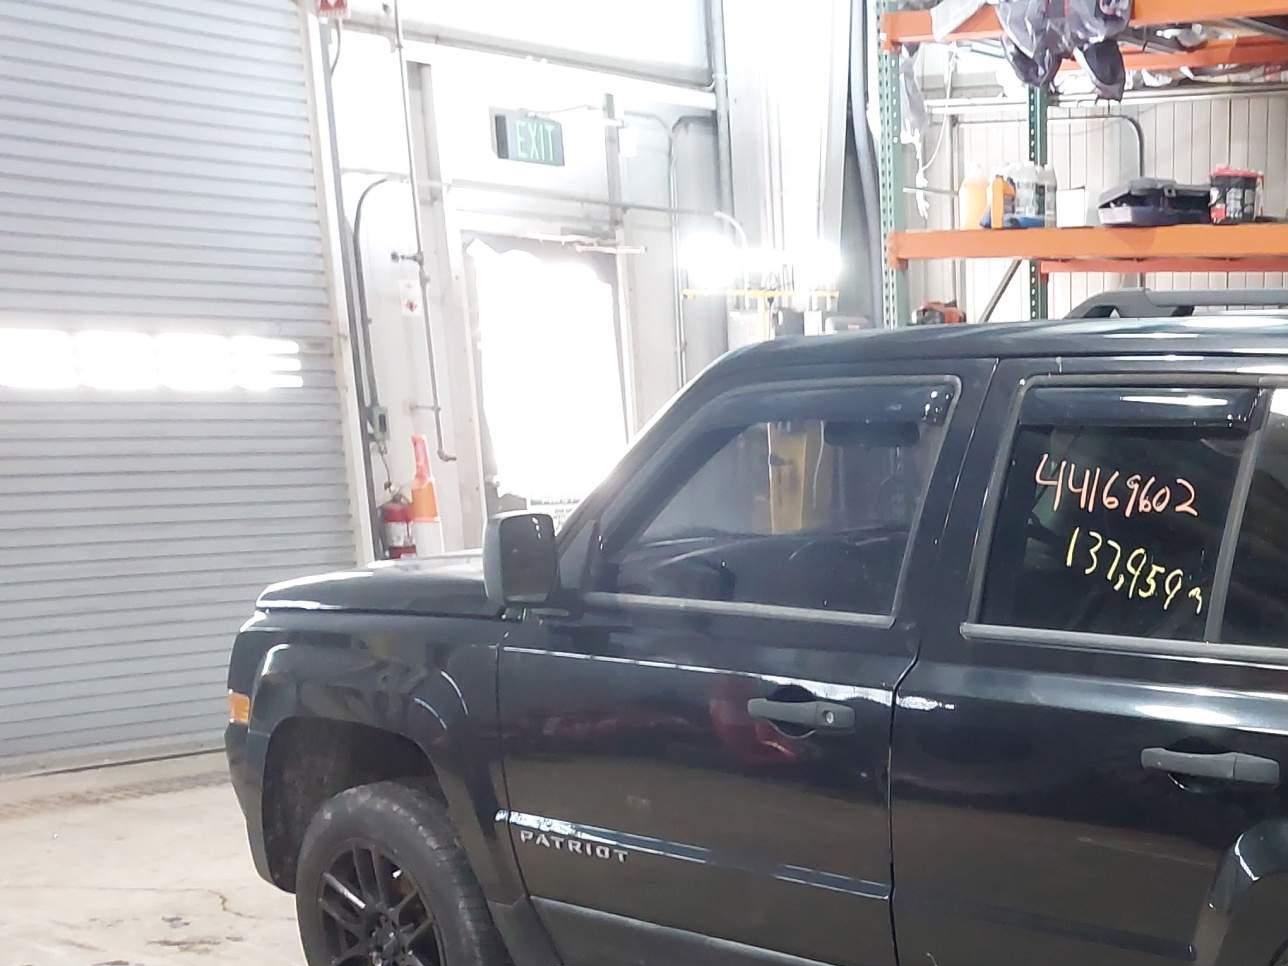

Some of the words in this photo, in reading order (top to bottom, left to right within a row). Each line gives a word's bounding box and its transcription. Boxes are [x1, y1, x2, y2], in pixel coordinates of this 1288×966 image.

[515, 120, 556, 161] EXIT
[1034, 453, 1199, 518] 44169602
[519, 829, 629, 863] PATRIOT
